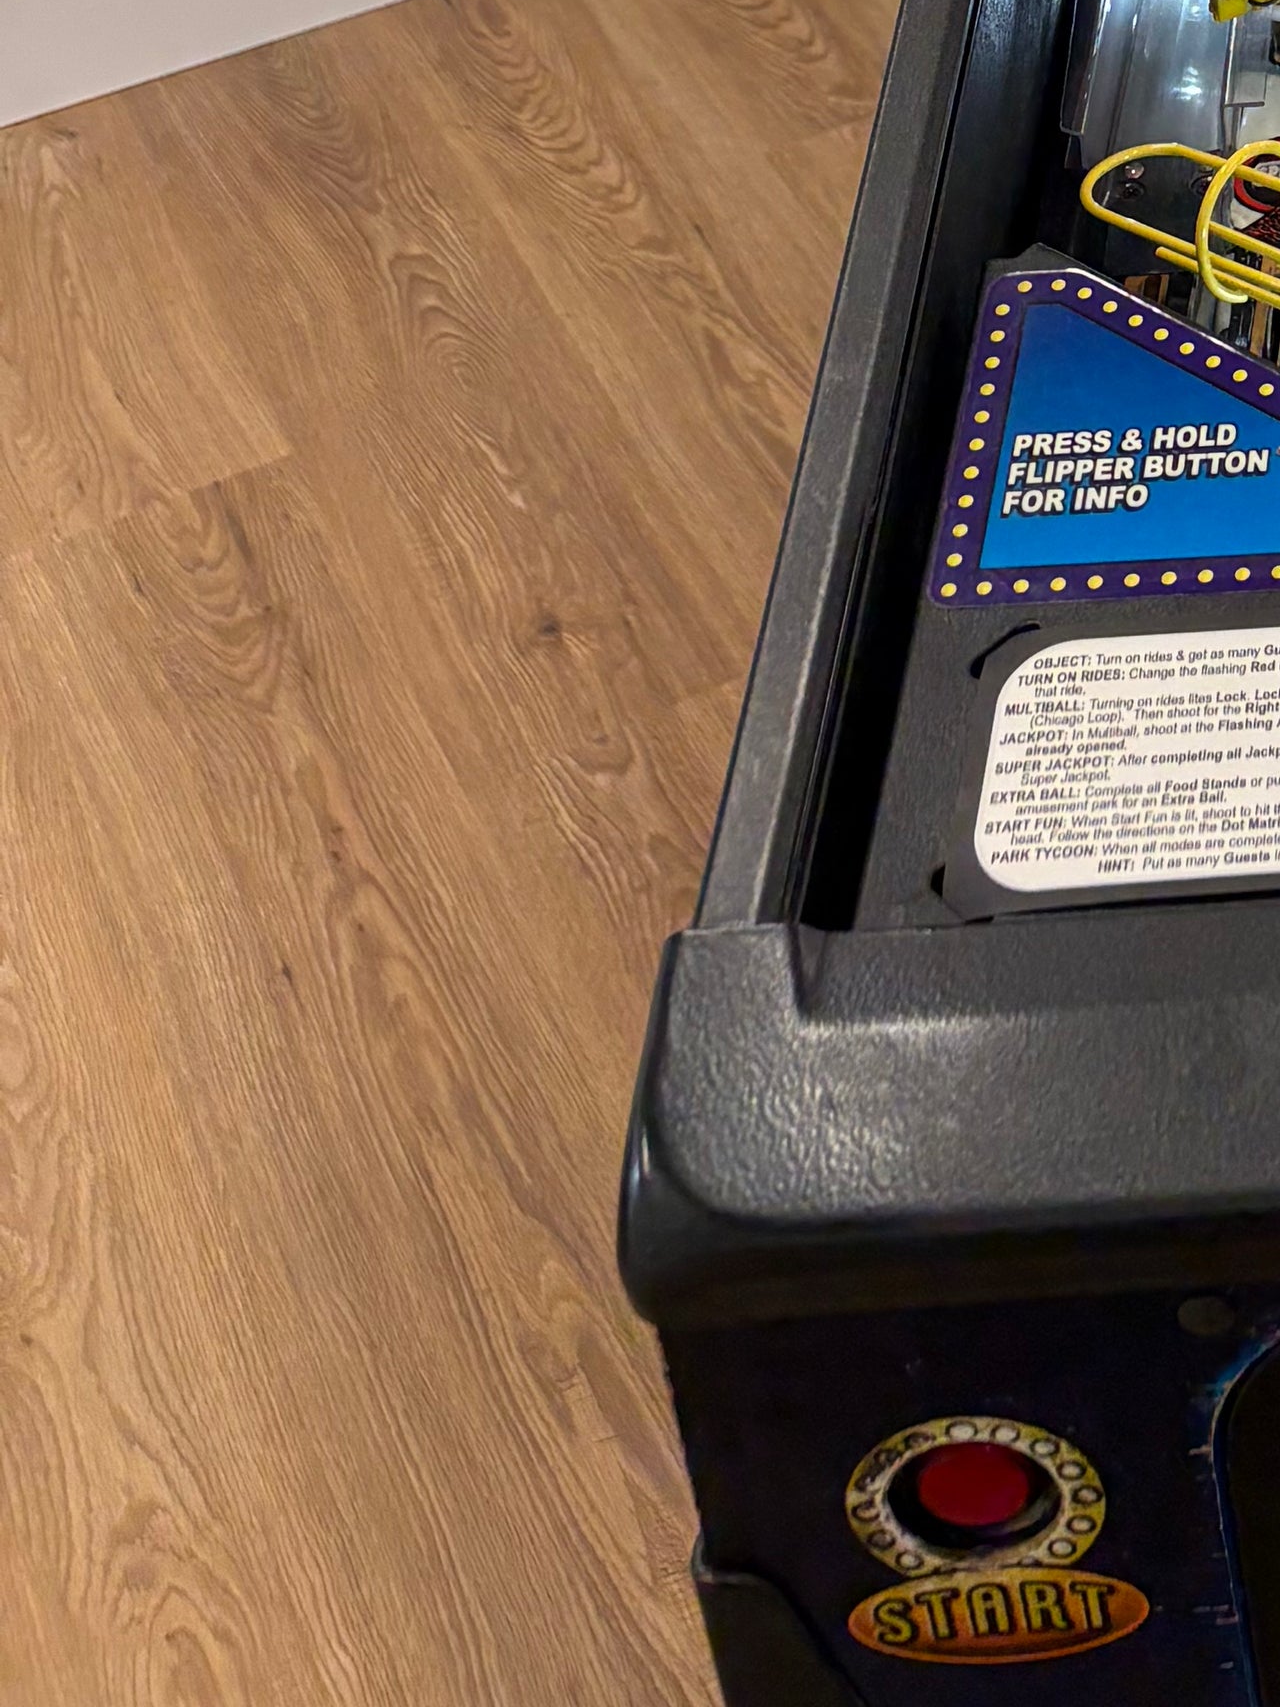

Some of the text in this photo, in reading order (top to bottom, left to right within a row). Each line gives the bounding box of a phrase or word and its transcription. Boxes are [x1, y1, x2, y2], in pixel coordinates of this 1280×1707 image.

[1012, 423, 1237, 458] PRESS & HOLD
[1007, 449, 1270, 486] FLIPPER BUTTON
[1002, 484, 1149, 515] FOR INFO
[1034, 654, 1091, 670] OBJECT:
[1097, 654, 1121, 665] Turn
[1126, 654, 1140, 664] on
[1144, 651, 1172, 663] rides
[1176, 649, 1184, 662] &
[1189, 649, 1207, 664] get
[1211, 650, 1224, 660] as
[1228, 647, 1260, 659] many
[872, 1580, 1115, 1644] START
